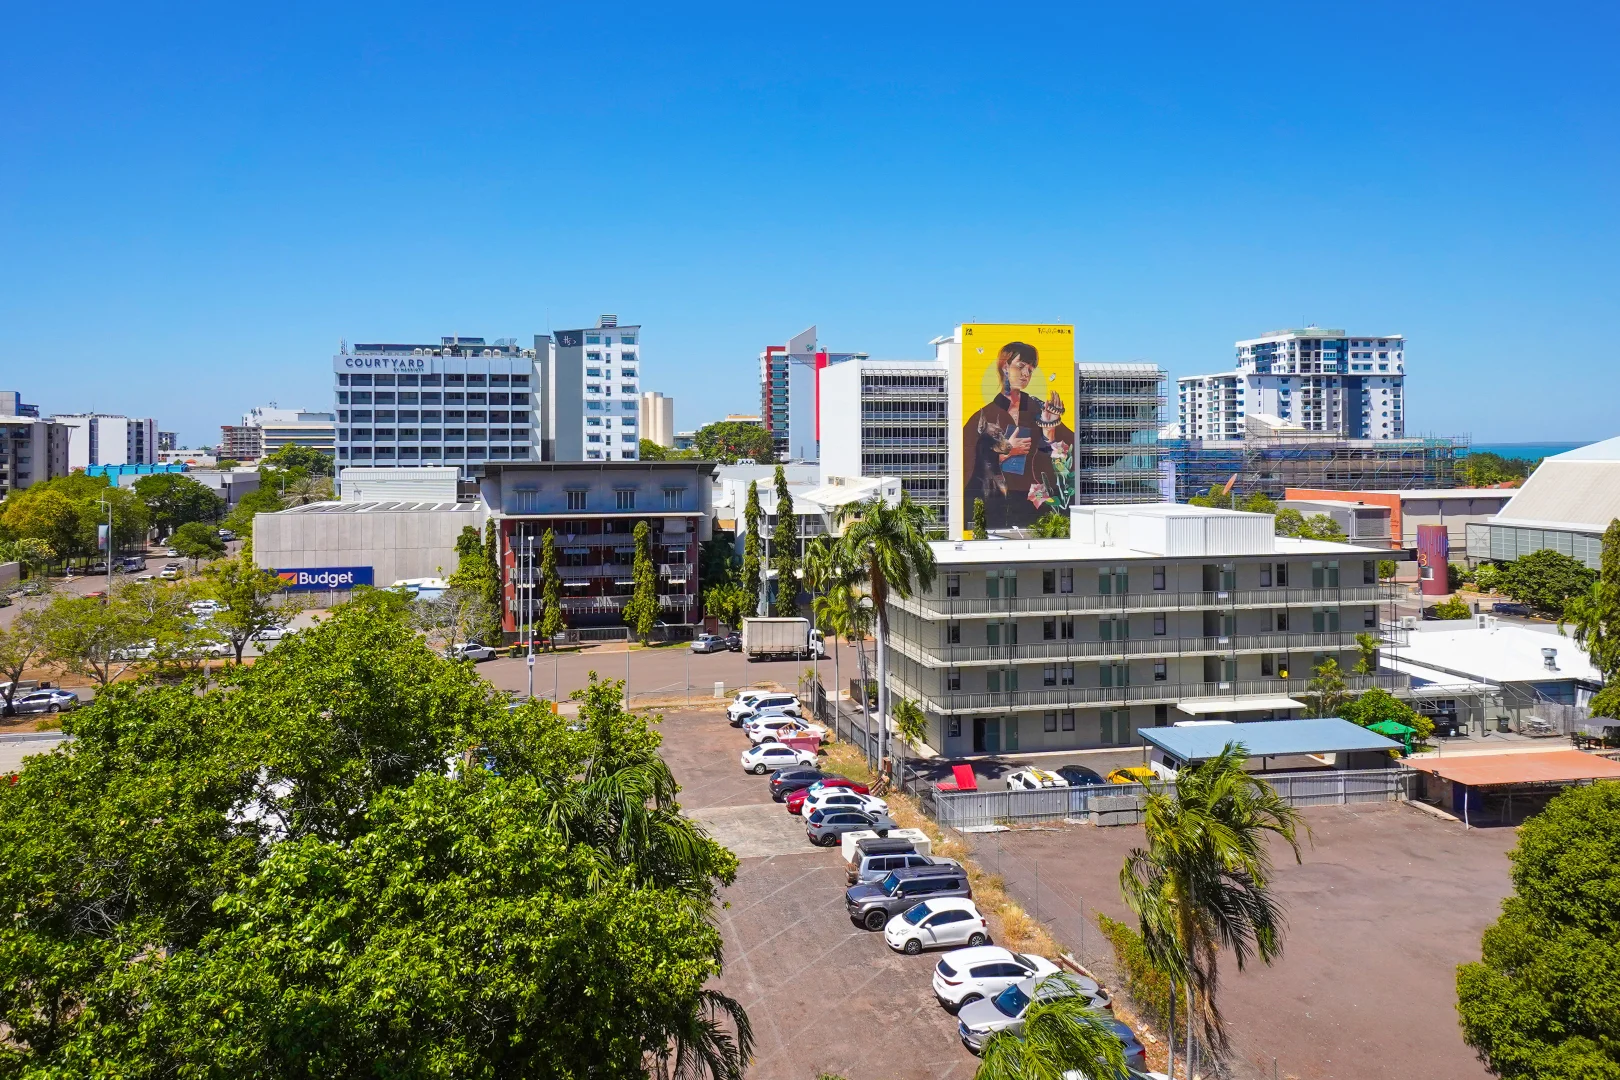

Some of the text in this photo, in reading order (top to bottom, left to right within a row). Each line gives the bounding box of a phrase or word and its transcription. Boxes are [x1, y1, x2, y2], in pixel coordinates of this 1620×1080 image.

[345, 358, 424, 368] COURTYARD
[299, 571, 353, 588] Budget
[567, 632, 578, 643] 12
